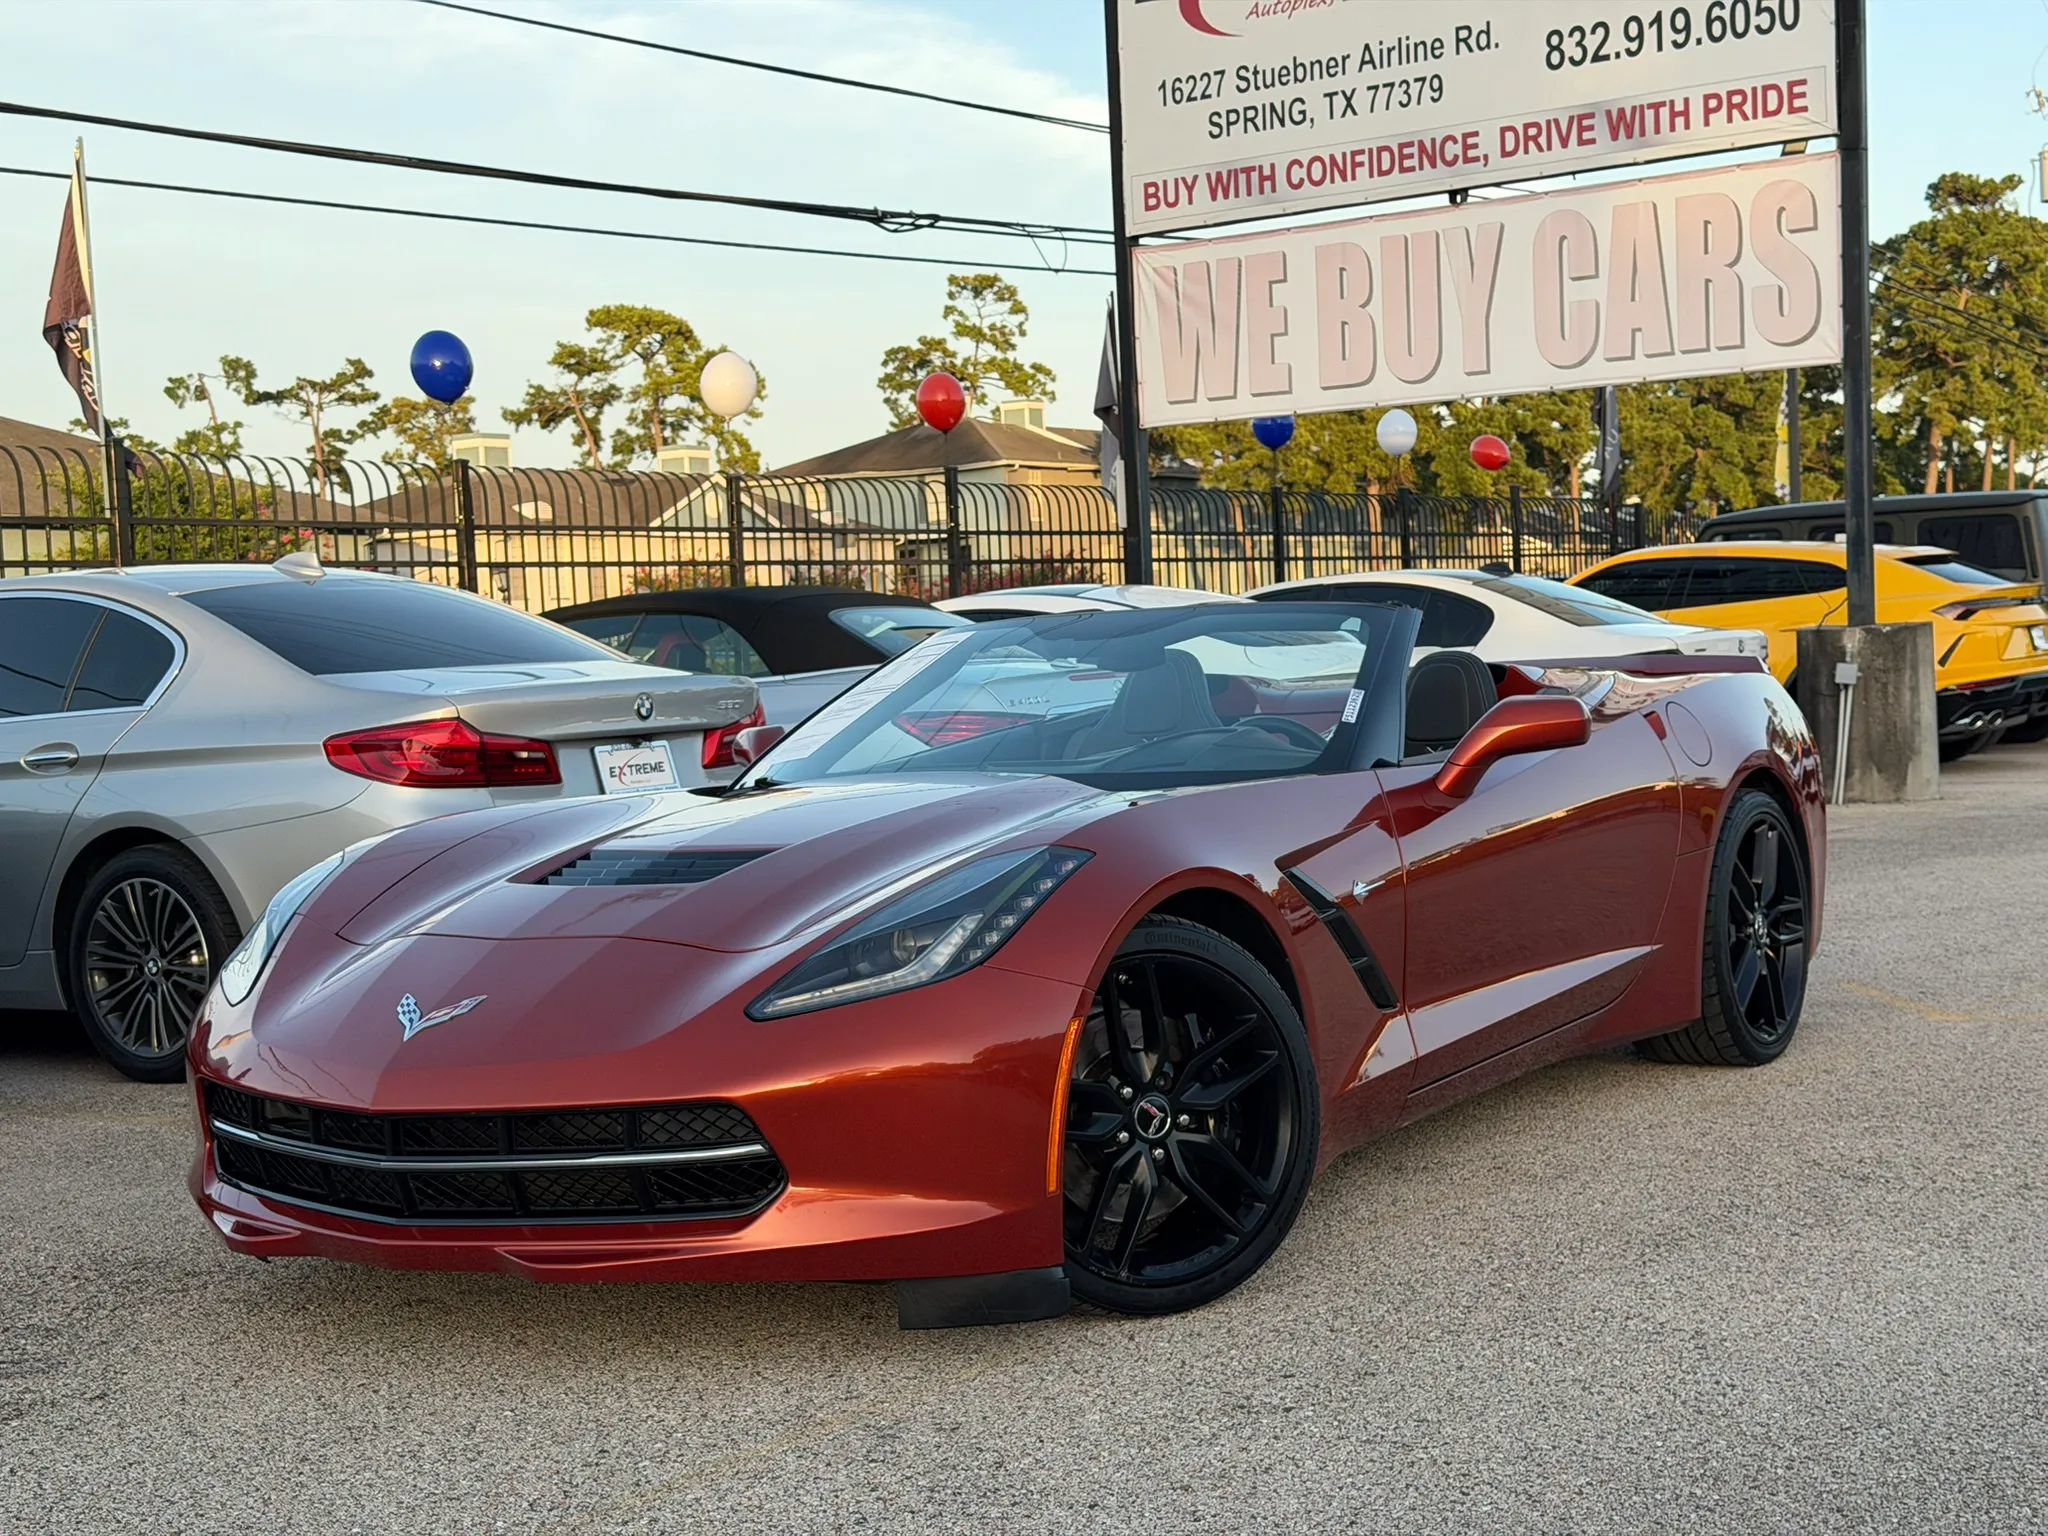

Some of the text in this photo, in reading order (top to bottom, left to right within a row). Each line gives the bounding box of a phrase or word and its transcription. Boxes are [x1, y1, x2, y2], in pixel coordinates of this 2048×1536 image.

[1157, 20, 1500, 107] 16227 Stuebner Airline Rd.
[1545, 0, 1800, 71] 832.919.6050
[1207, 73, 1445, 140] SPRING, TX 77379
[1142, 79, 1809, 213] BUY WITH CONFIDENCE, DRIVE WITH PRIDE
[1152, 178, 1823, 404] WE BUY CARS
[608, 761, 666, 779] EXTREME
[1144, 931, 1210, 953] Continental
